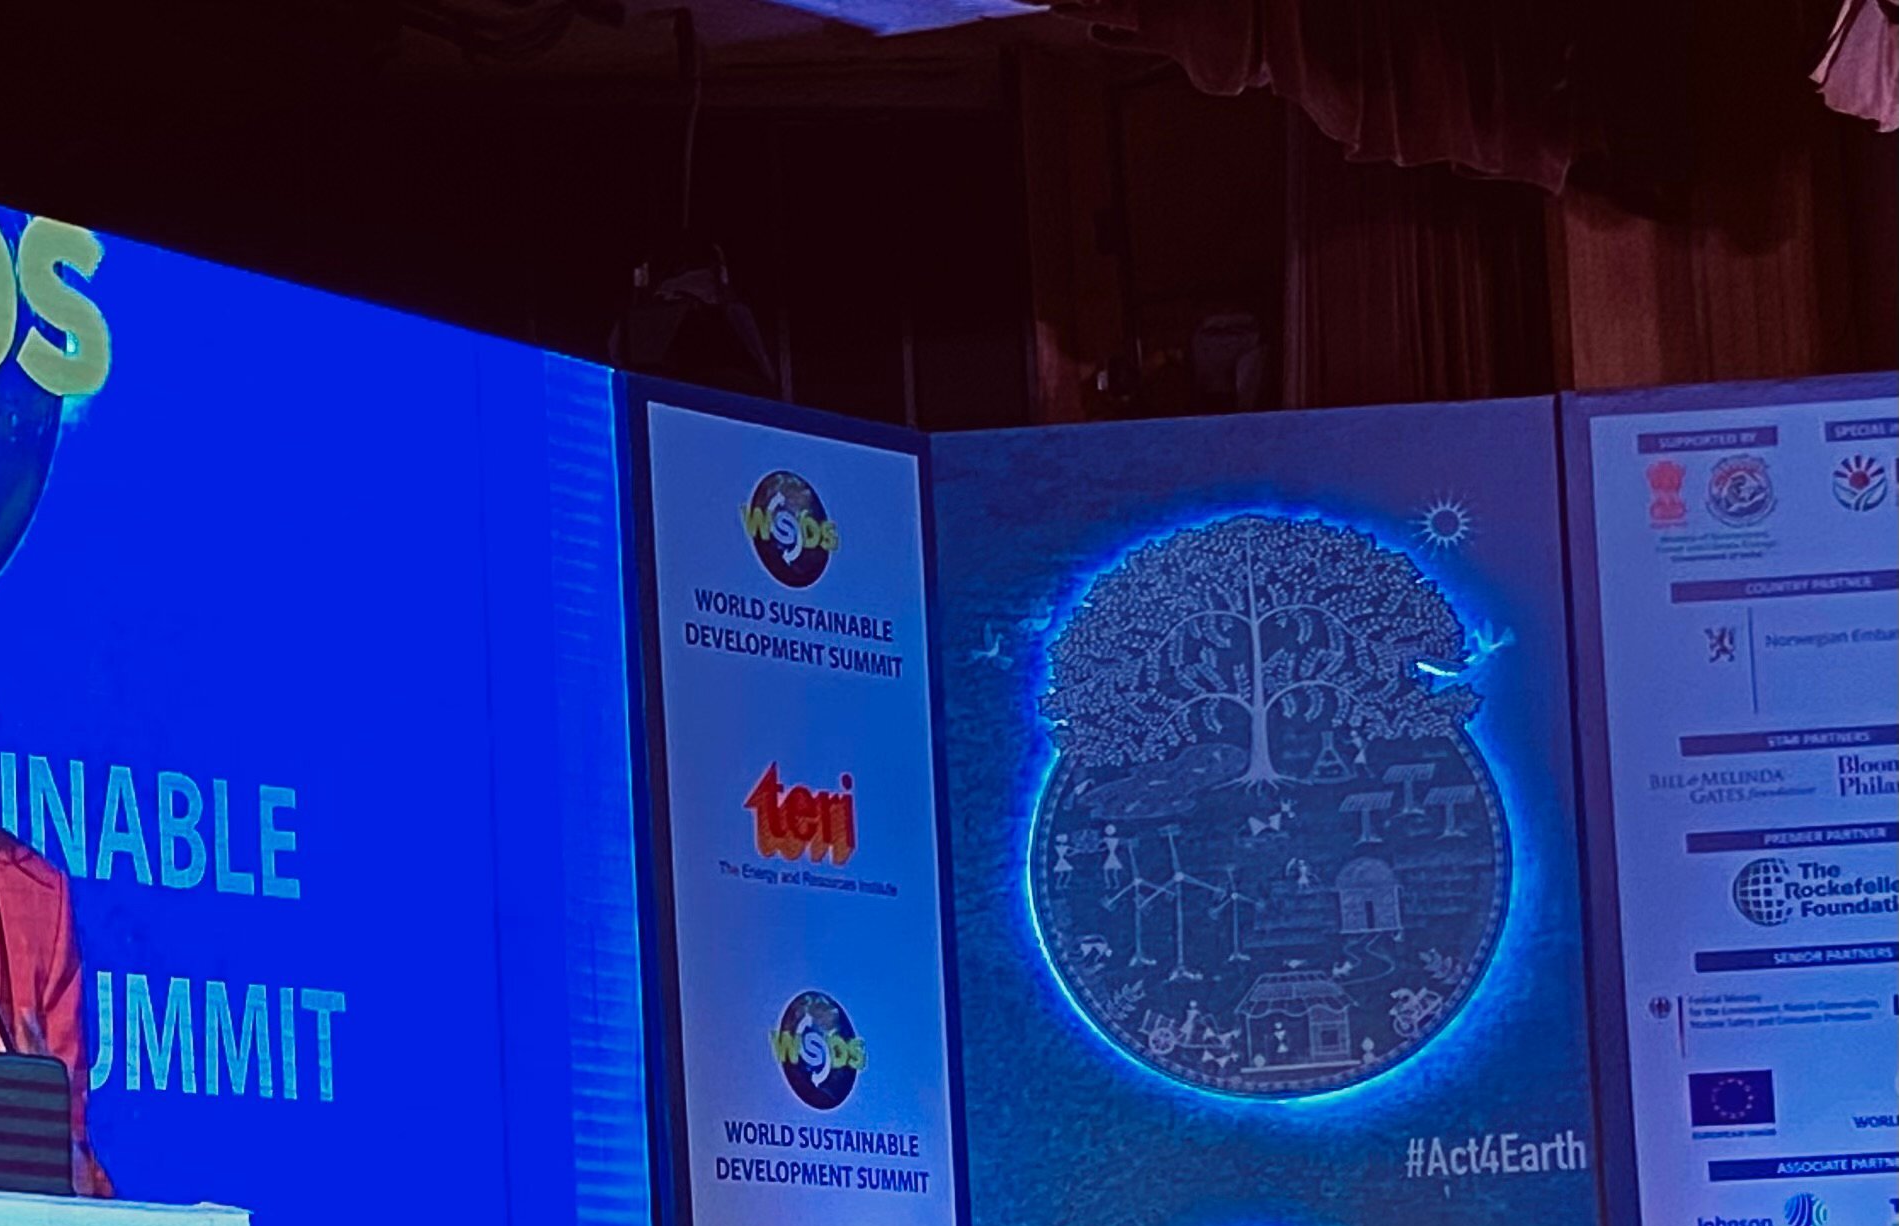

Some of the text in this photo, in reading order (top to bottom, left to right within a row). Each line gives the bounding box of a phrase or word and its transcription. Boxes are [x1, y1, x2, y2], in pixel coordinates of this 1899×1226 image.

[695, 588, 893, 643] WORLD SUSTAINABLE
[685, 622, 902, 678] DEVELOPMENT SUMMIT
[1702, 768, 1786, 786] MELINDA
[1839, 776, 1899, 797] Phila
[0, 752, 300, 900] INABLE
[743, 760, 857, 867] teri
[1797, 862, 1841, 880] The
[1774, 946, 1894, 965] SENIOR PARTNERS
[89, 970, 345, 1102] UMMIT
[724, 1120, 920, 1158] WORLD SUSTAINABLE
[1405, 1130, 1588, 1179] #Act4Earth
[716, 1157, 930, 1194] DEVELOPMENT SUMMIT
[1777, 1158, 1847, 1174] ASSOCIATE
